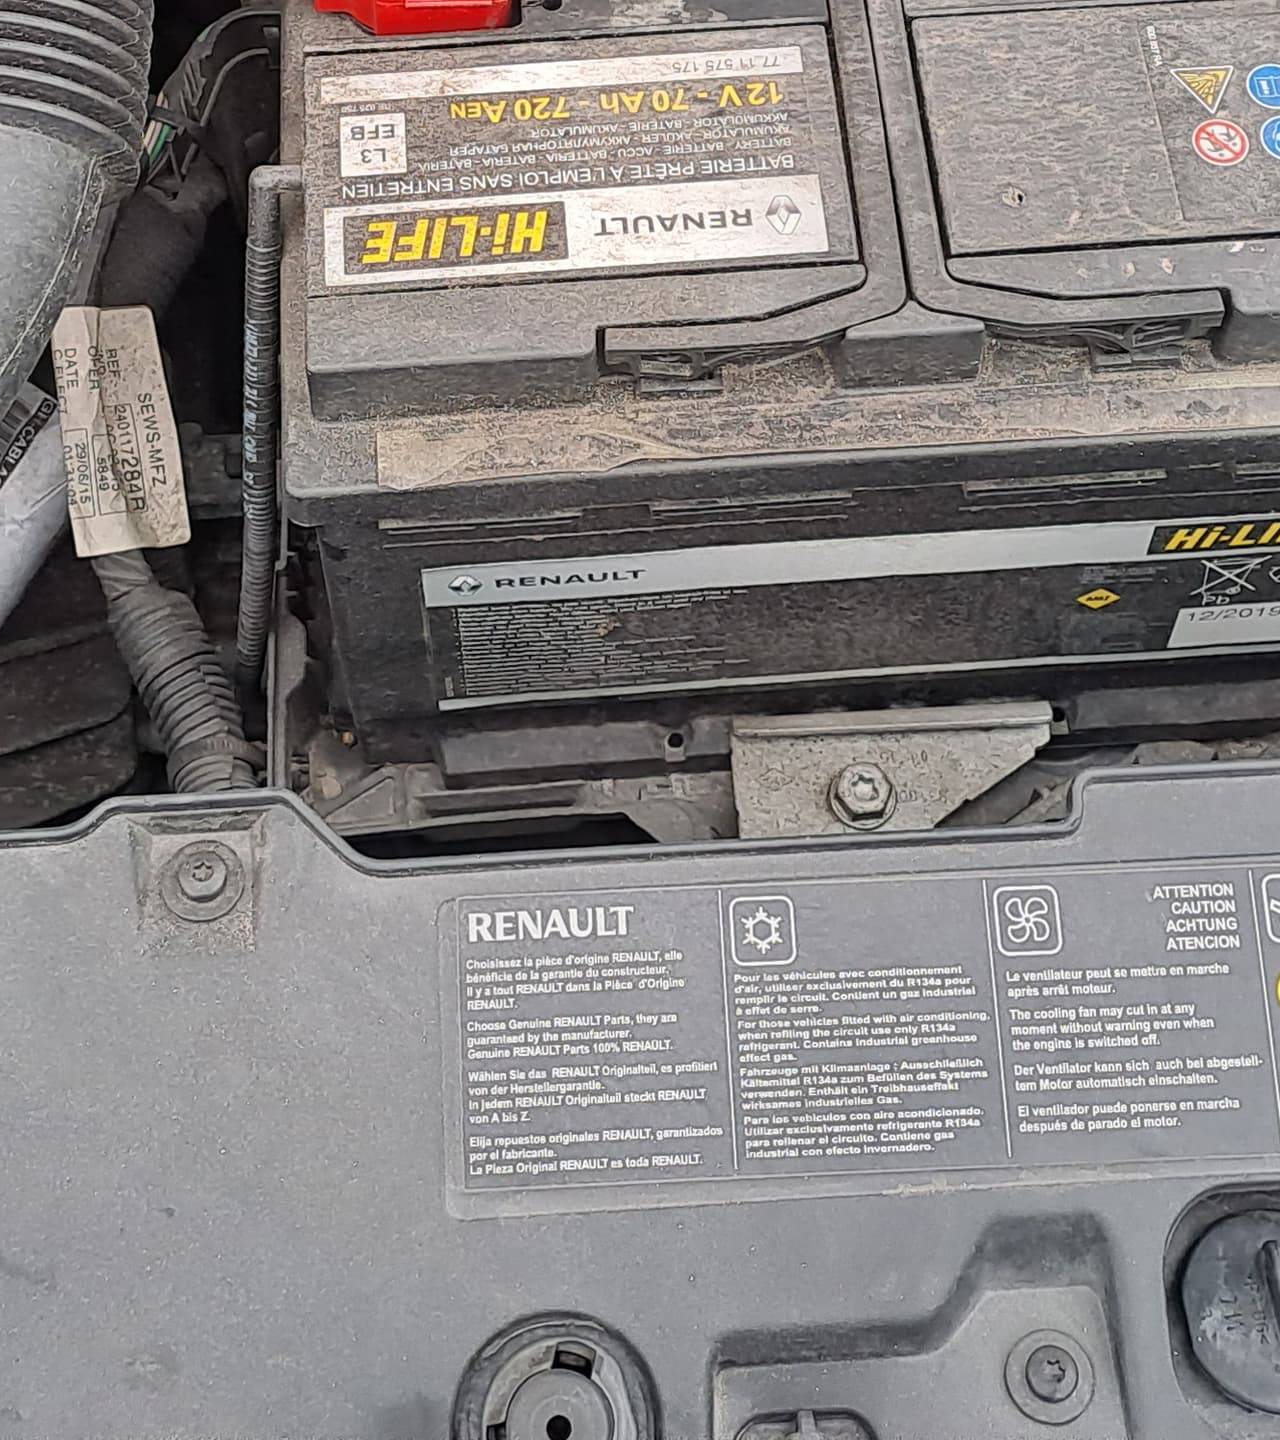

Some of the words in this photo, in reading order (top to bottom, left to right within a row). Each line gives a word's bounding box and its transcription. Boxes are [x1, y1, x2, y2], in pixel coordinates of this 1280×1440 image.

[671, 61, 698, 72] 175
[704, 58, 732, 70] 575
[762, 54, 778, 66] 77
[513, 95, 570, 120] 720
[599, 89, 643, 113] Ah
[650, 88, 688, 111] 70
[349, 122, 394, 139] EFB
[627, 119, 681, 130] BATERIE
[616, 145, 652, 157] ACCU
[662, 141, 723, 153] BATTERIE
[733, 136, 791, 149] BATTERY
[359, 147, 385, 163] L3
[545, 149, 606, 162] BATTERIA
[698, 153, 793, 174] BATTERIE
[518, 165, 604, 186] L'EMPLOI
[609, 165, 622, 181] À
[629, 160, 694, 179] PRÊTE
[341, 176, 452, 198] ENTRETIEN
[458, 172, 512, 190] SANS
[592, 207, 752, 236] RENAULT
[359, 208, 547, 264] Hi-LIFE
[63, 347, 78, 390] DATE
[136, 392, 166, 488] SEWS-MFZ
[113, 404, 145, 511] 240117284R
[74, 442, 90, 504] 29/06/15
[95, 457, 108, 491] 5849
[494, 568, 648, 589] RENAULT
[1152, 883, 1235, 899] ATTENTION
[1171, 900, 1237, 915] CAUTION
[469, 906, 634, 943] RENAULT
[1165, 916, 1238, 933] ACHTUNG
[1166, 934, 1241, 951] ATENCION
[466, 955, 521, 970] Choisissez
[523, 955, 533, 967] la
[535, 954, 562, 969] pièce
[564, 951, 609, 968] d'origine
[612, 949, 662, 965] RENAULT,
[664, 948, 682, 961] elle
[514, 968, 527, 981] de
[530, 968, 539, 980] la
[541, 966, 582, 982] garantie
[585, 965, 598, 978] du
[601, 962, 670, 977] constructeur.
[1008, 1008, 1031, 1021] The
[1033, 1006, 1076, 1022] cooling
[1078, 1006, 1096, 1018] fan
[1099, 1007, 1123, 1020] may
[1126, 1004, 1144, 1016] cut
[1146, 1003, 1158, 1015] in
[1160, 1002, 1172, 1015] at
[1174, 1004, 1194, 1017] any
[466, 1019, 506, 1033] Choose
[508, 1017, 551, 1031] Genuine
[553, 1015, 602, 1029] RENAULT
[603, 1013, 633, 1029] Parts,
[635, 1012, 658, 1027] they
[660, 1014, 677, 1024] are
[1010, 1022, 1057, 1036] moment
[1059, 1020, 1103, 1034] without
[1104, 1018, 1150, 1034] warning
[1153, 1020, 1180, 1030] even
[1182, 1016, 1214, 1029] when
[1012, 1038, 1030, 1051] the
[1033, 1037, 1072, 1052] engine
[1074, 1036, 1085, 1048] is
[1087, 1034, 1138, 1048] switched
[1141, 1034, 1160, 1046] off.
